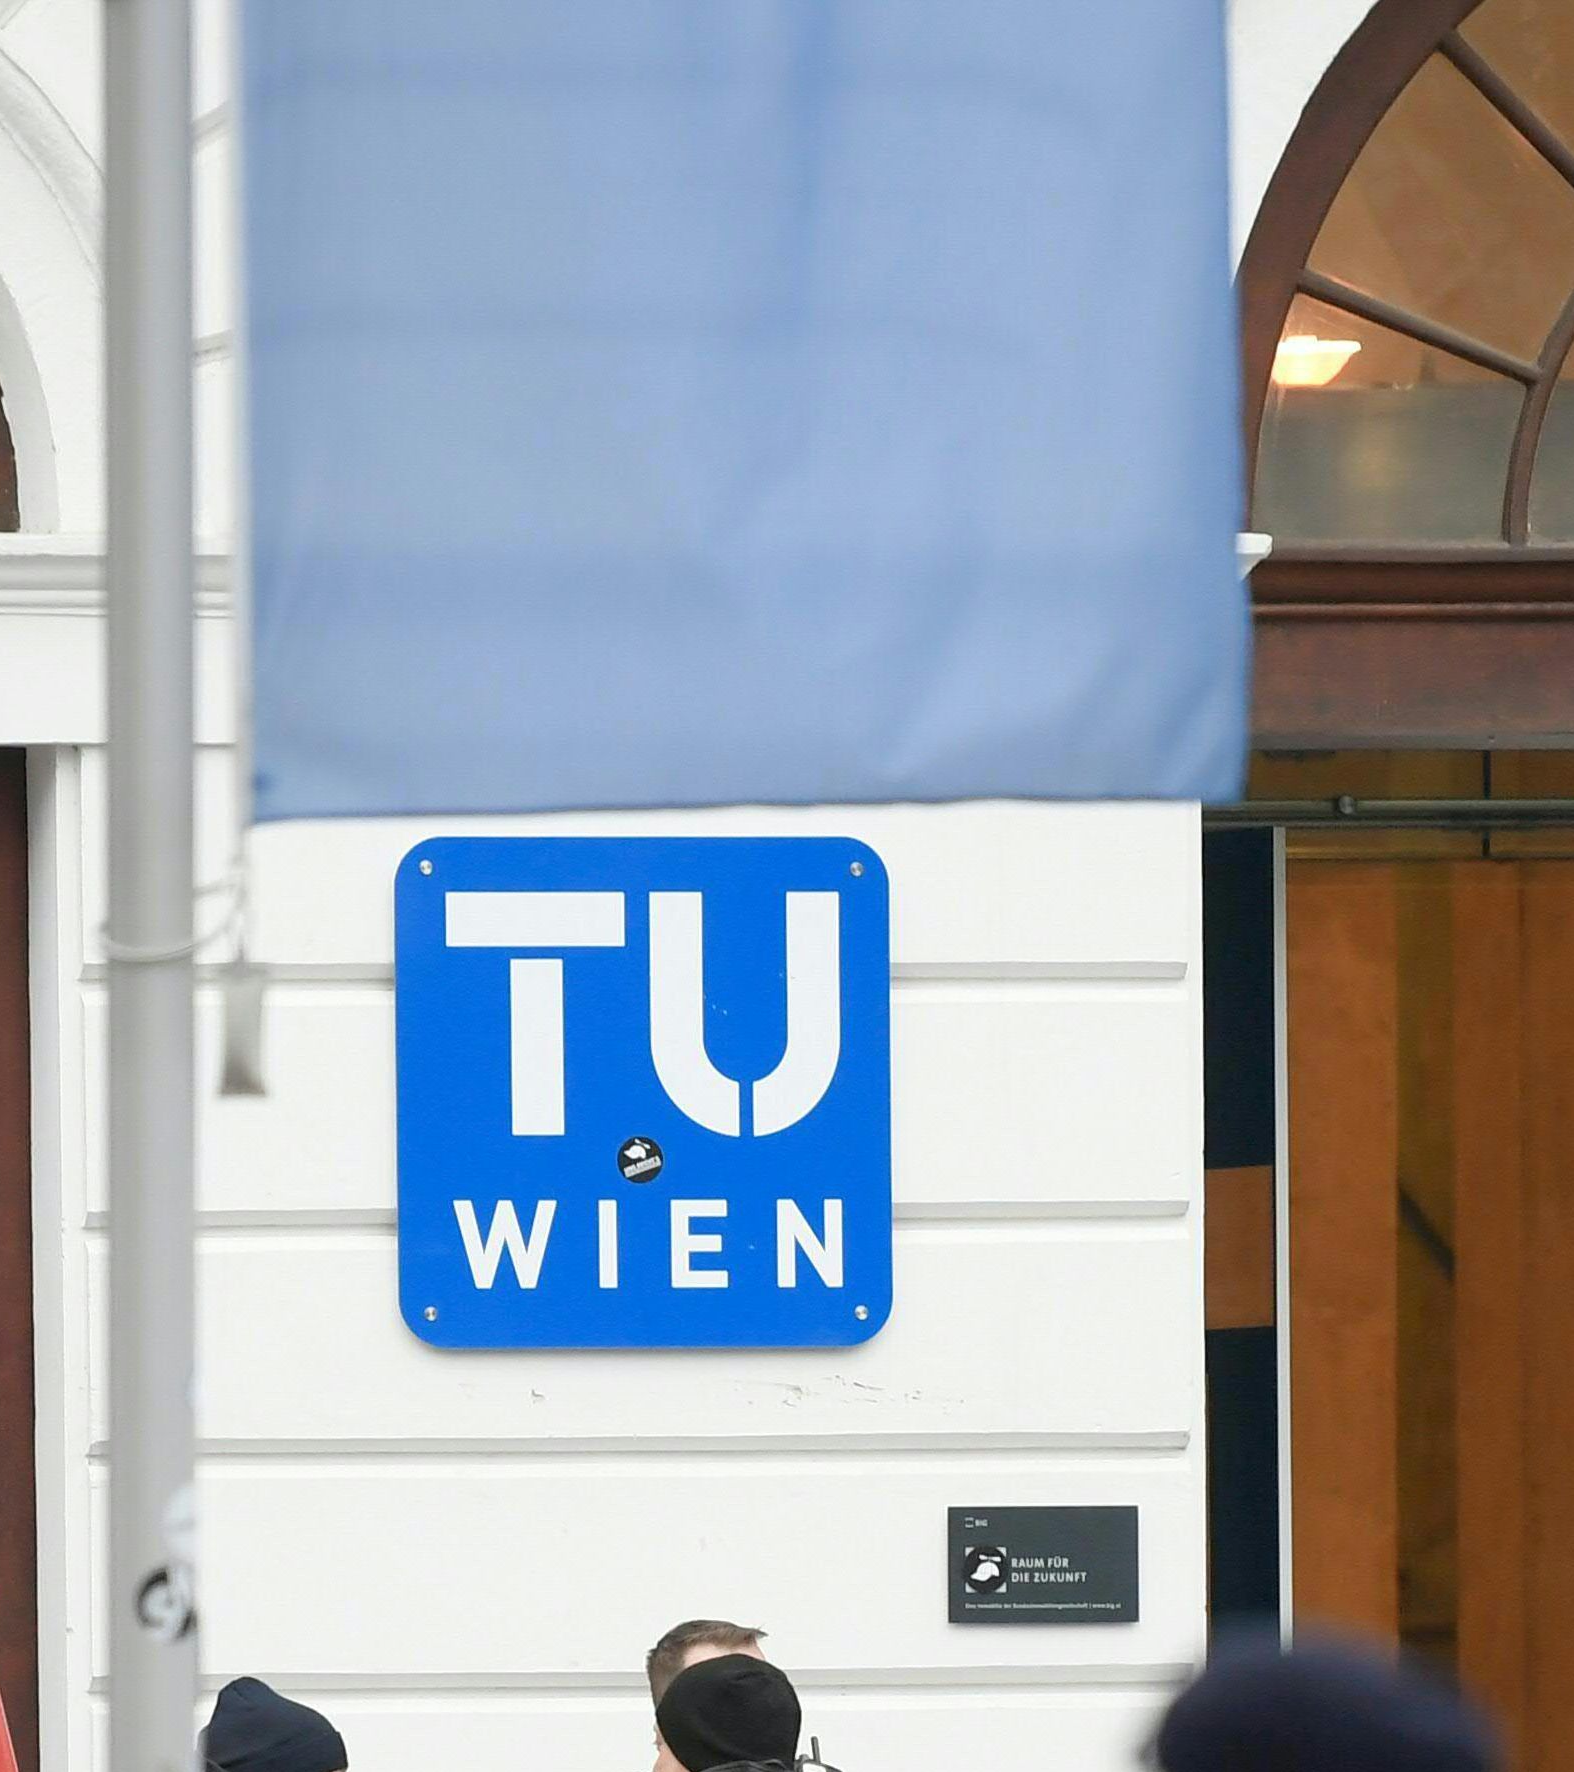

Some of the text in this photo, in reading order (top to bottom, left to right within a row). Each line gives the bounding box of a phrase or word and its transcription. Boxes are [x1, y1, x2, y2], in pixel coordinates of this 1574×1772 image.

[444, 890, 841, 1138] TU
[452, 1198, 844, 1290] WIEN
[1011, 1556, 1070, 1569] RAUM FÜR
[1011, 1572, 1087, 1583] DIE ZUKUNFT
